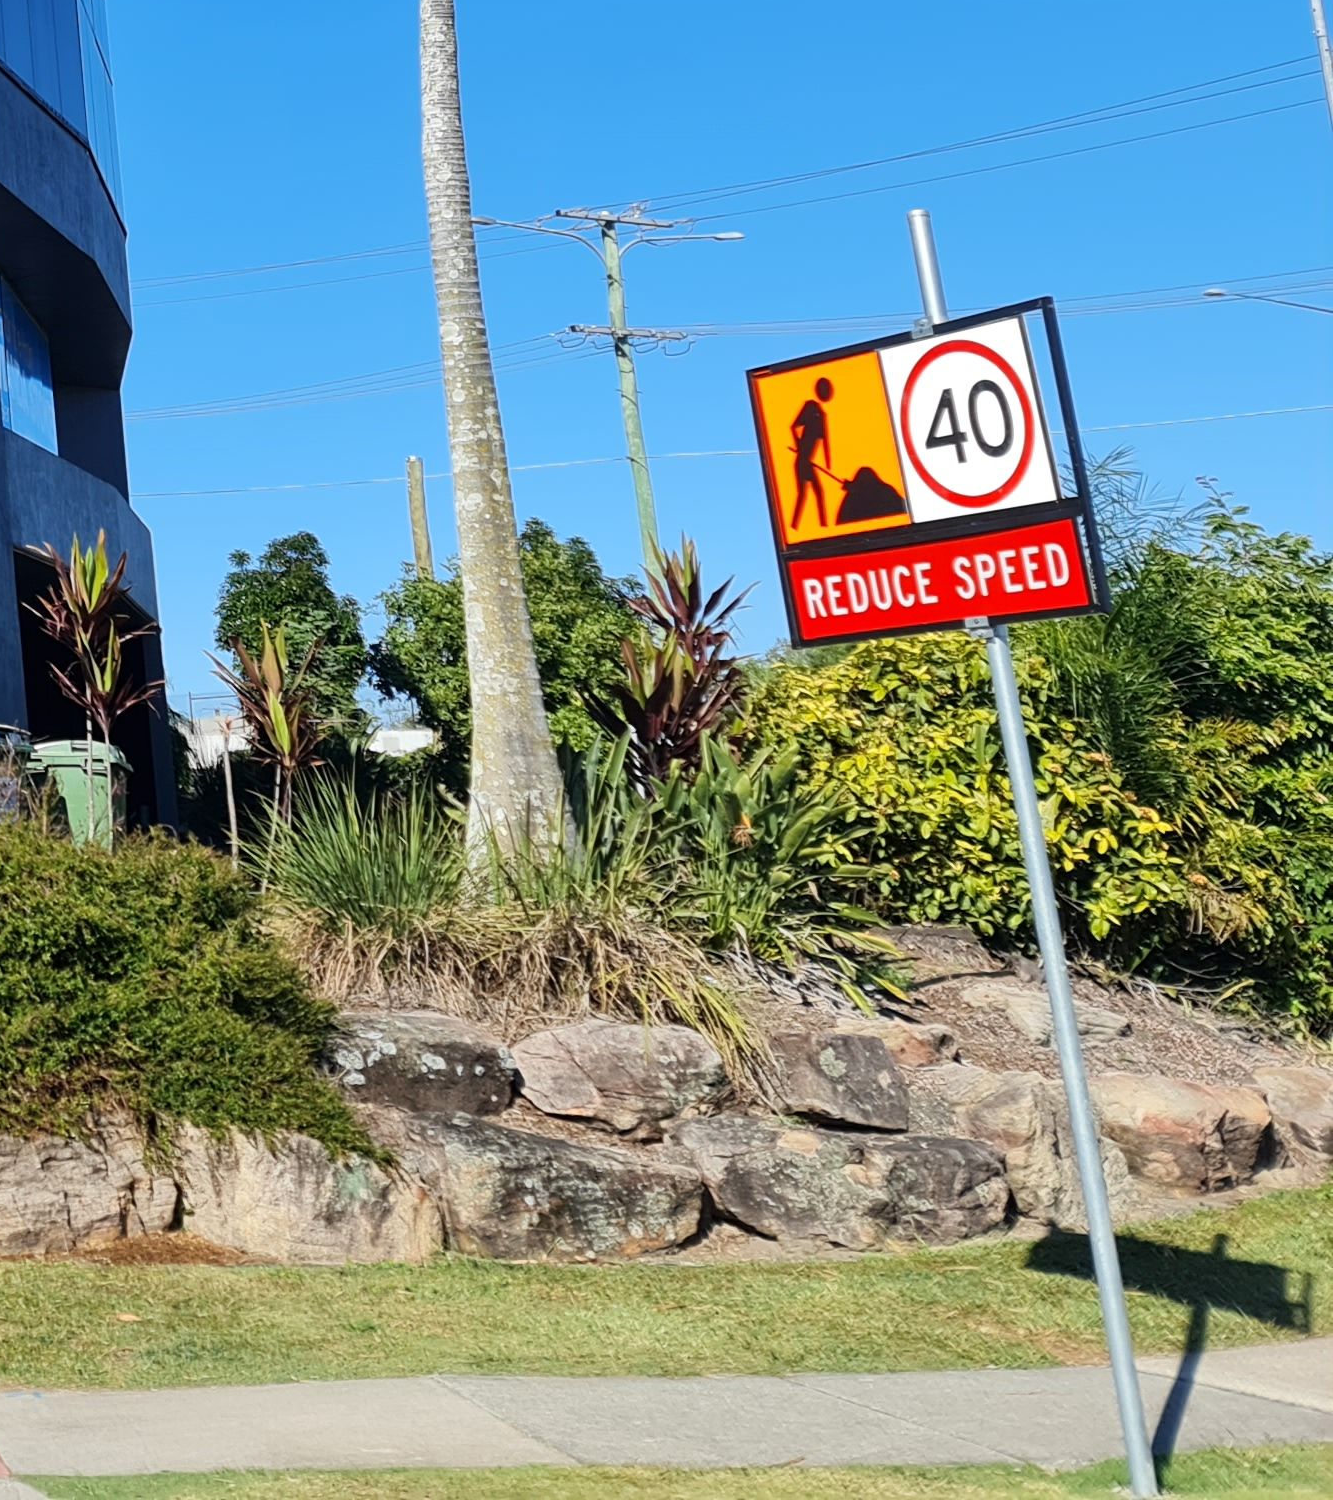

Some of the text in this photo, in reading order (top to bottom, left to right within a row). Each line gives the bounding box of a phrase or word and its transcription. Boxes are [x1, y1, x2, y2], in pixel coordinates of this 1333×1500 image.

[925, 379, 1014, 464] 40
[802, 542, 1071, 619] REDUCE SPEED
